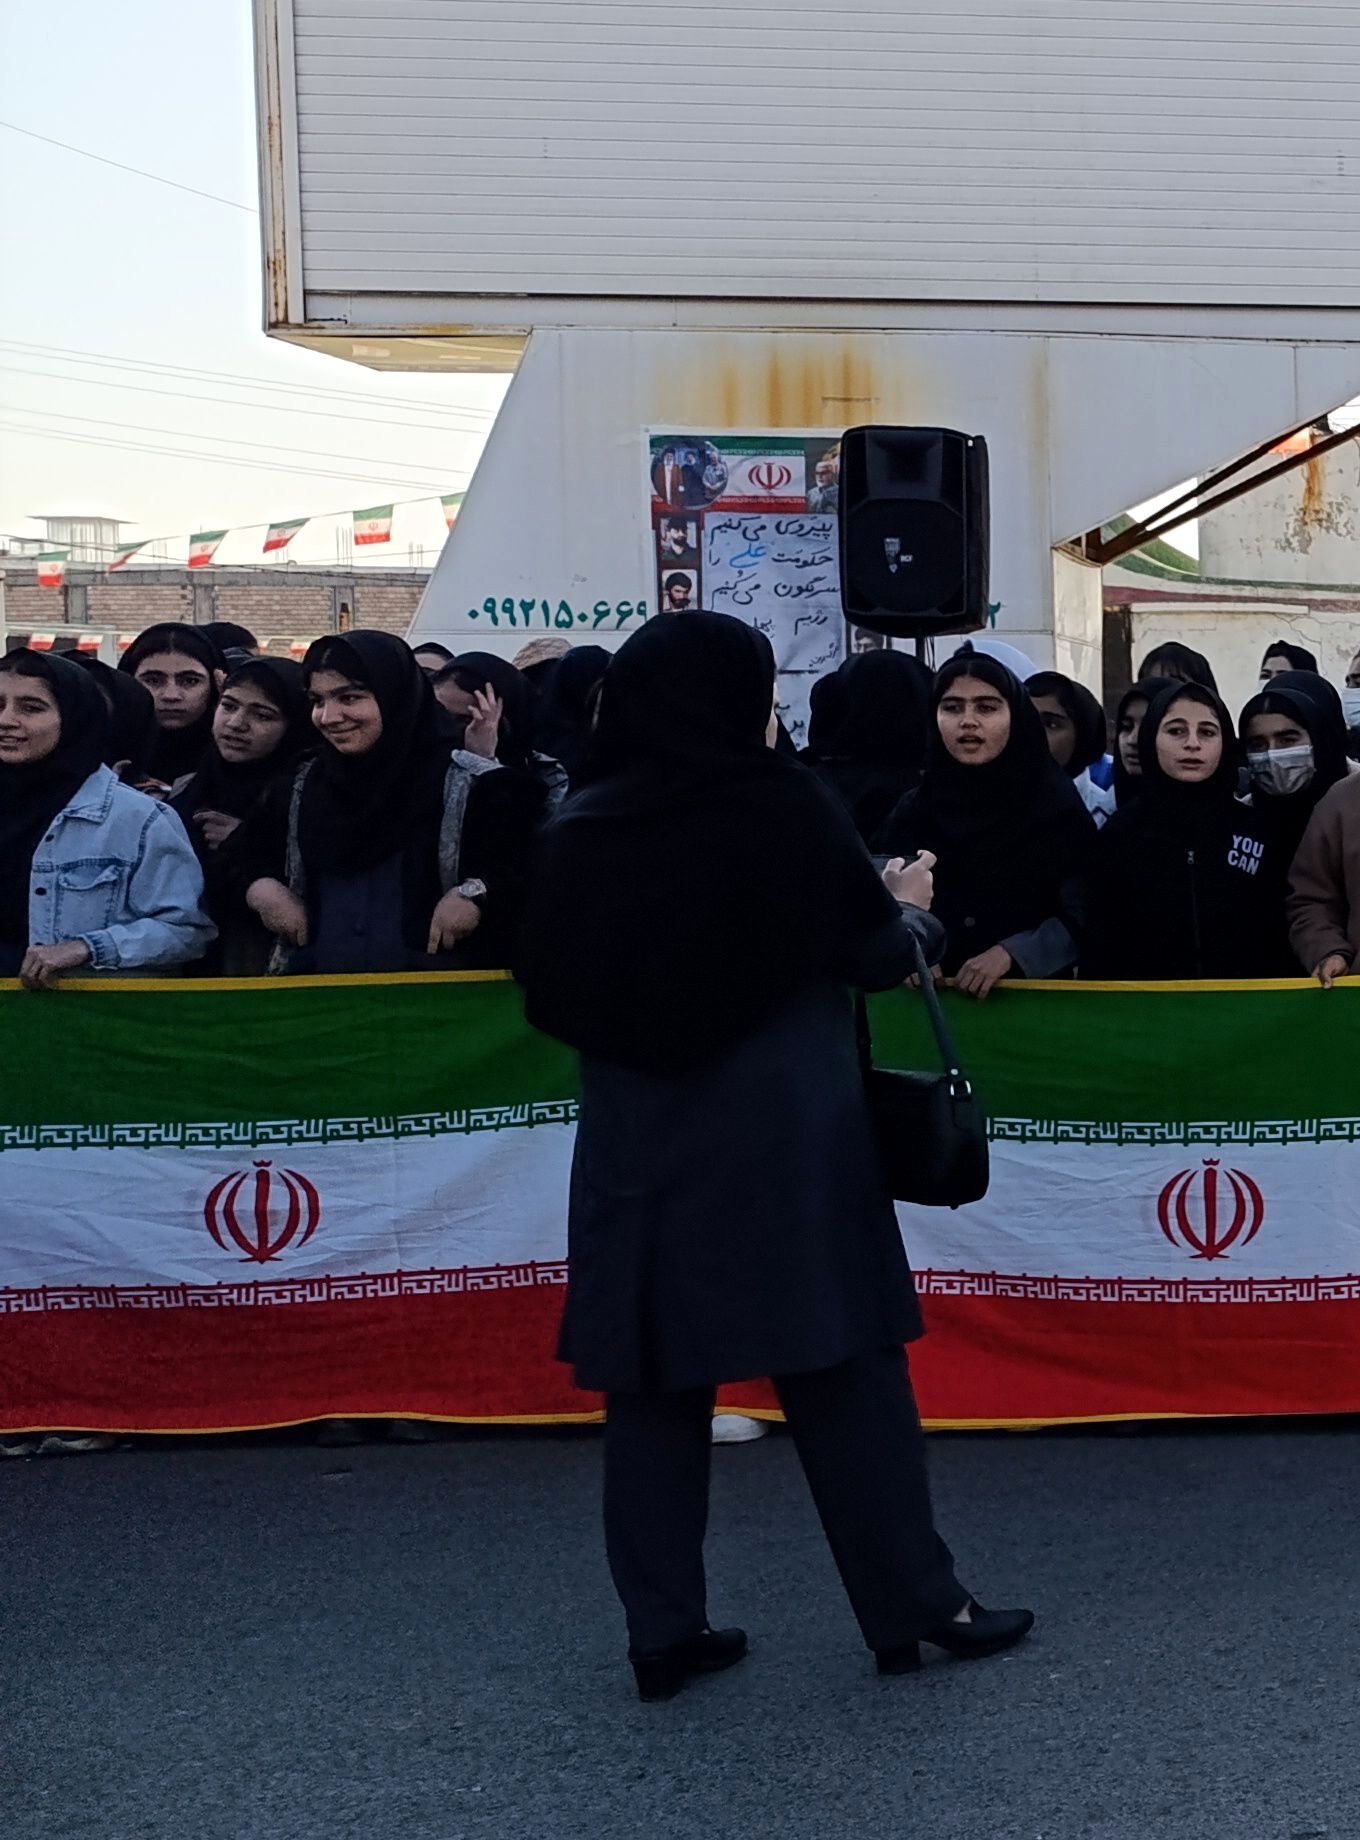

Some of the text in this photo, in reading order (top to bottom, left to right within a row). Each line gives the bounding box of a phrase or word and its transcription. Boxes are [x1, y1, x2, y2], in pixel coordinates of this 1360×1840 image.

[708, 548, 721, 566] را
[729, 543, 768, 568] علی
[1232, 834, 1265, 858] YOU
[1227, 849, 1260, 875] CAN
